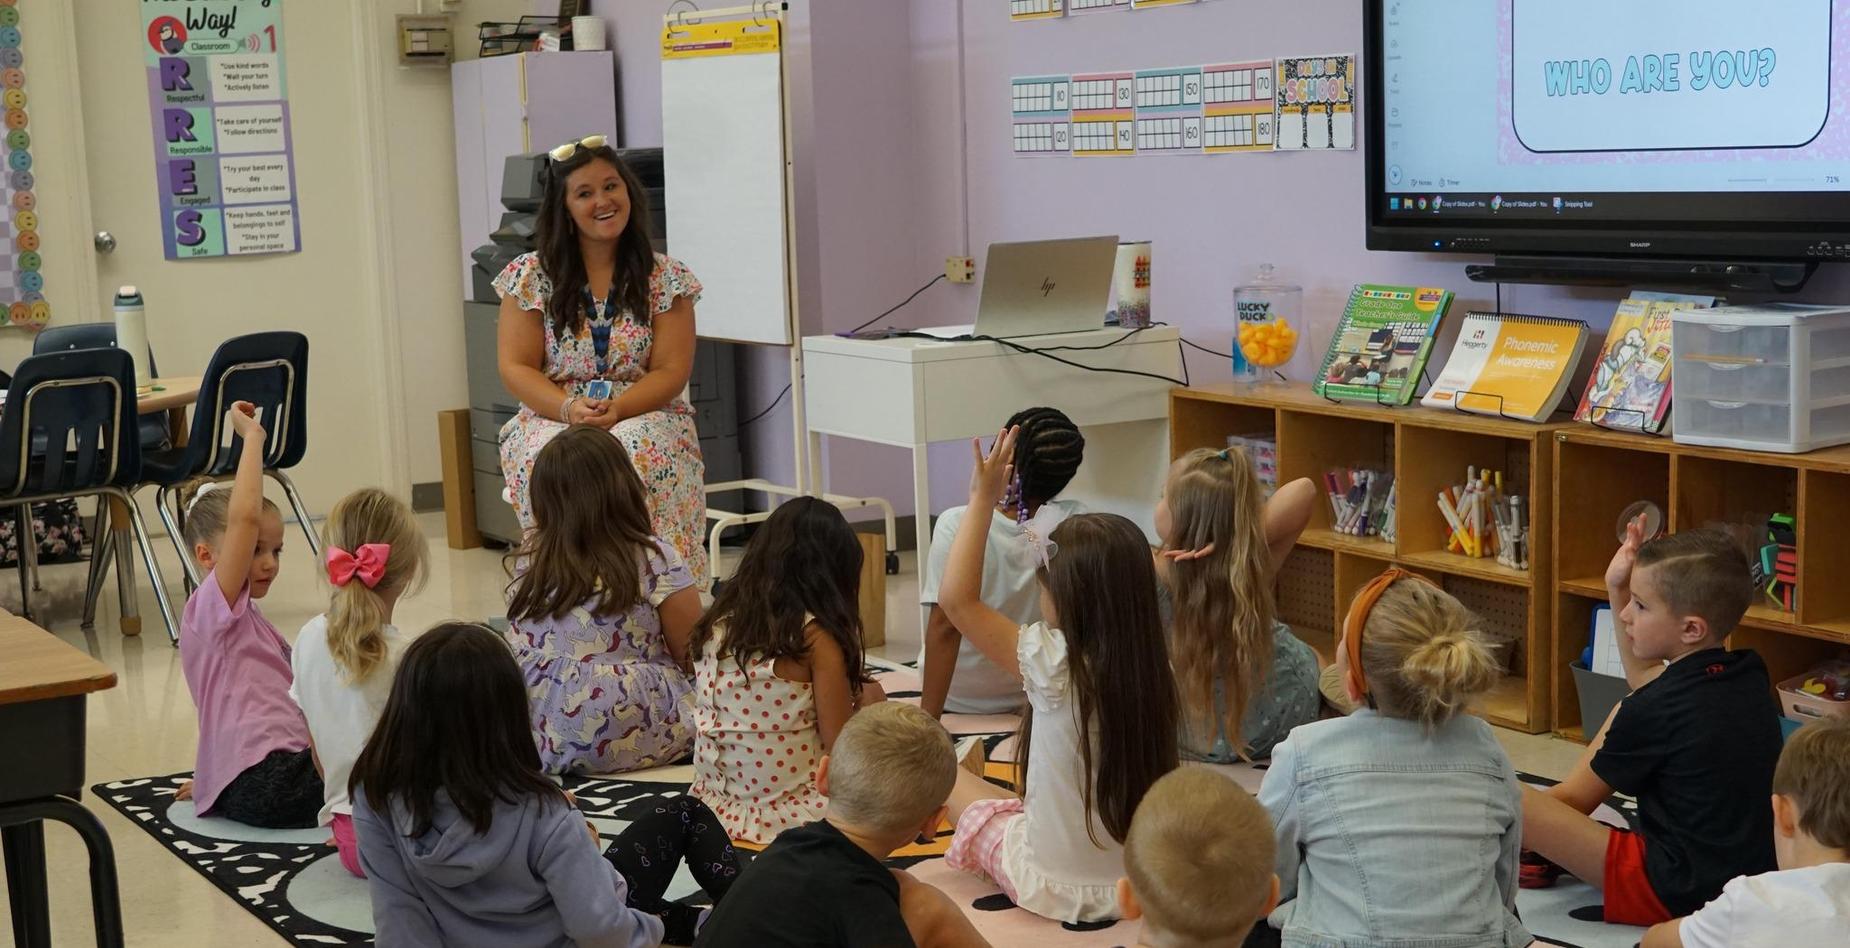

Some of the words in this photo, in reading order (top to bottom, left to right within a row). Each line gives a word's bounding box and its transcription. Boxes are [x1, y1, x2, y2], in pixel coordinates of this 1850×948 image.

[186, 5, 237, 38] Way!
[263, 24, 277, 53] 1
[191, 42, 230, 51] Classroom
[159, 57, 194, 91] R
[1297, 60, 1325, 77] DAYS
[1544, 58, 1612, 97] WHO
[1620, 53, 1680, 94] ARE
[1689, 47, 1776, 91] YOU?
[1185, 83, 1198, 96] 150
[1257, 77, 1270, 90] 170
[1285, 77, 1349, 103] SCHOOL
[166, 94, 205, 103] Respectful
[163, 109, 198, 142] R
[1258, 122, 1270, 135] 180
[1185, 126, 1198, 139] 160
[170, 146, 213, 155] Responsible
[168, 159, 198, 196] E
[1825, 175, 1841, 183] 71%
[180, 197, 211, 206] Engaged
[175, 209, 208, 247] S
[192, 247, 208, 255] Safe
[1041, 277, 1056, 297] hp
[1237, 302, 1270, 312] LUCKY
[1360, 299, 1386, 308] Grade
[1239, 312, 1266, 321] DUCK
[1462, 339, 1488, 349] Heggerty
[1503, 337, 1559, 353] Phonemic
[1496, 354, 1556, 370] Awareness
